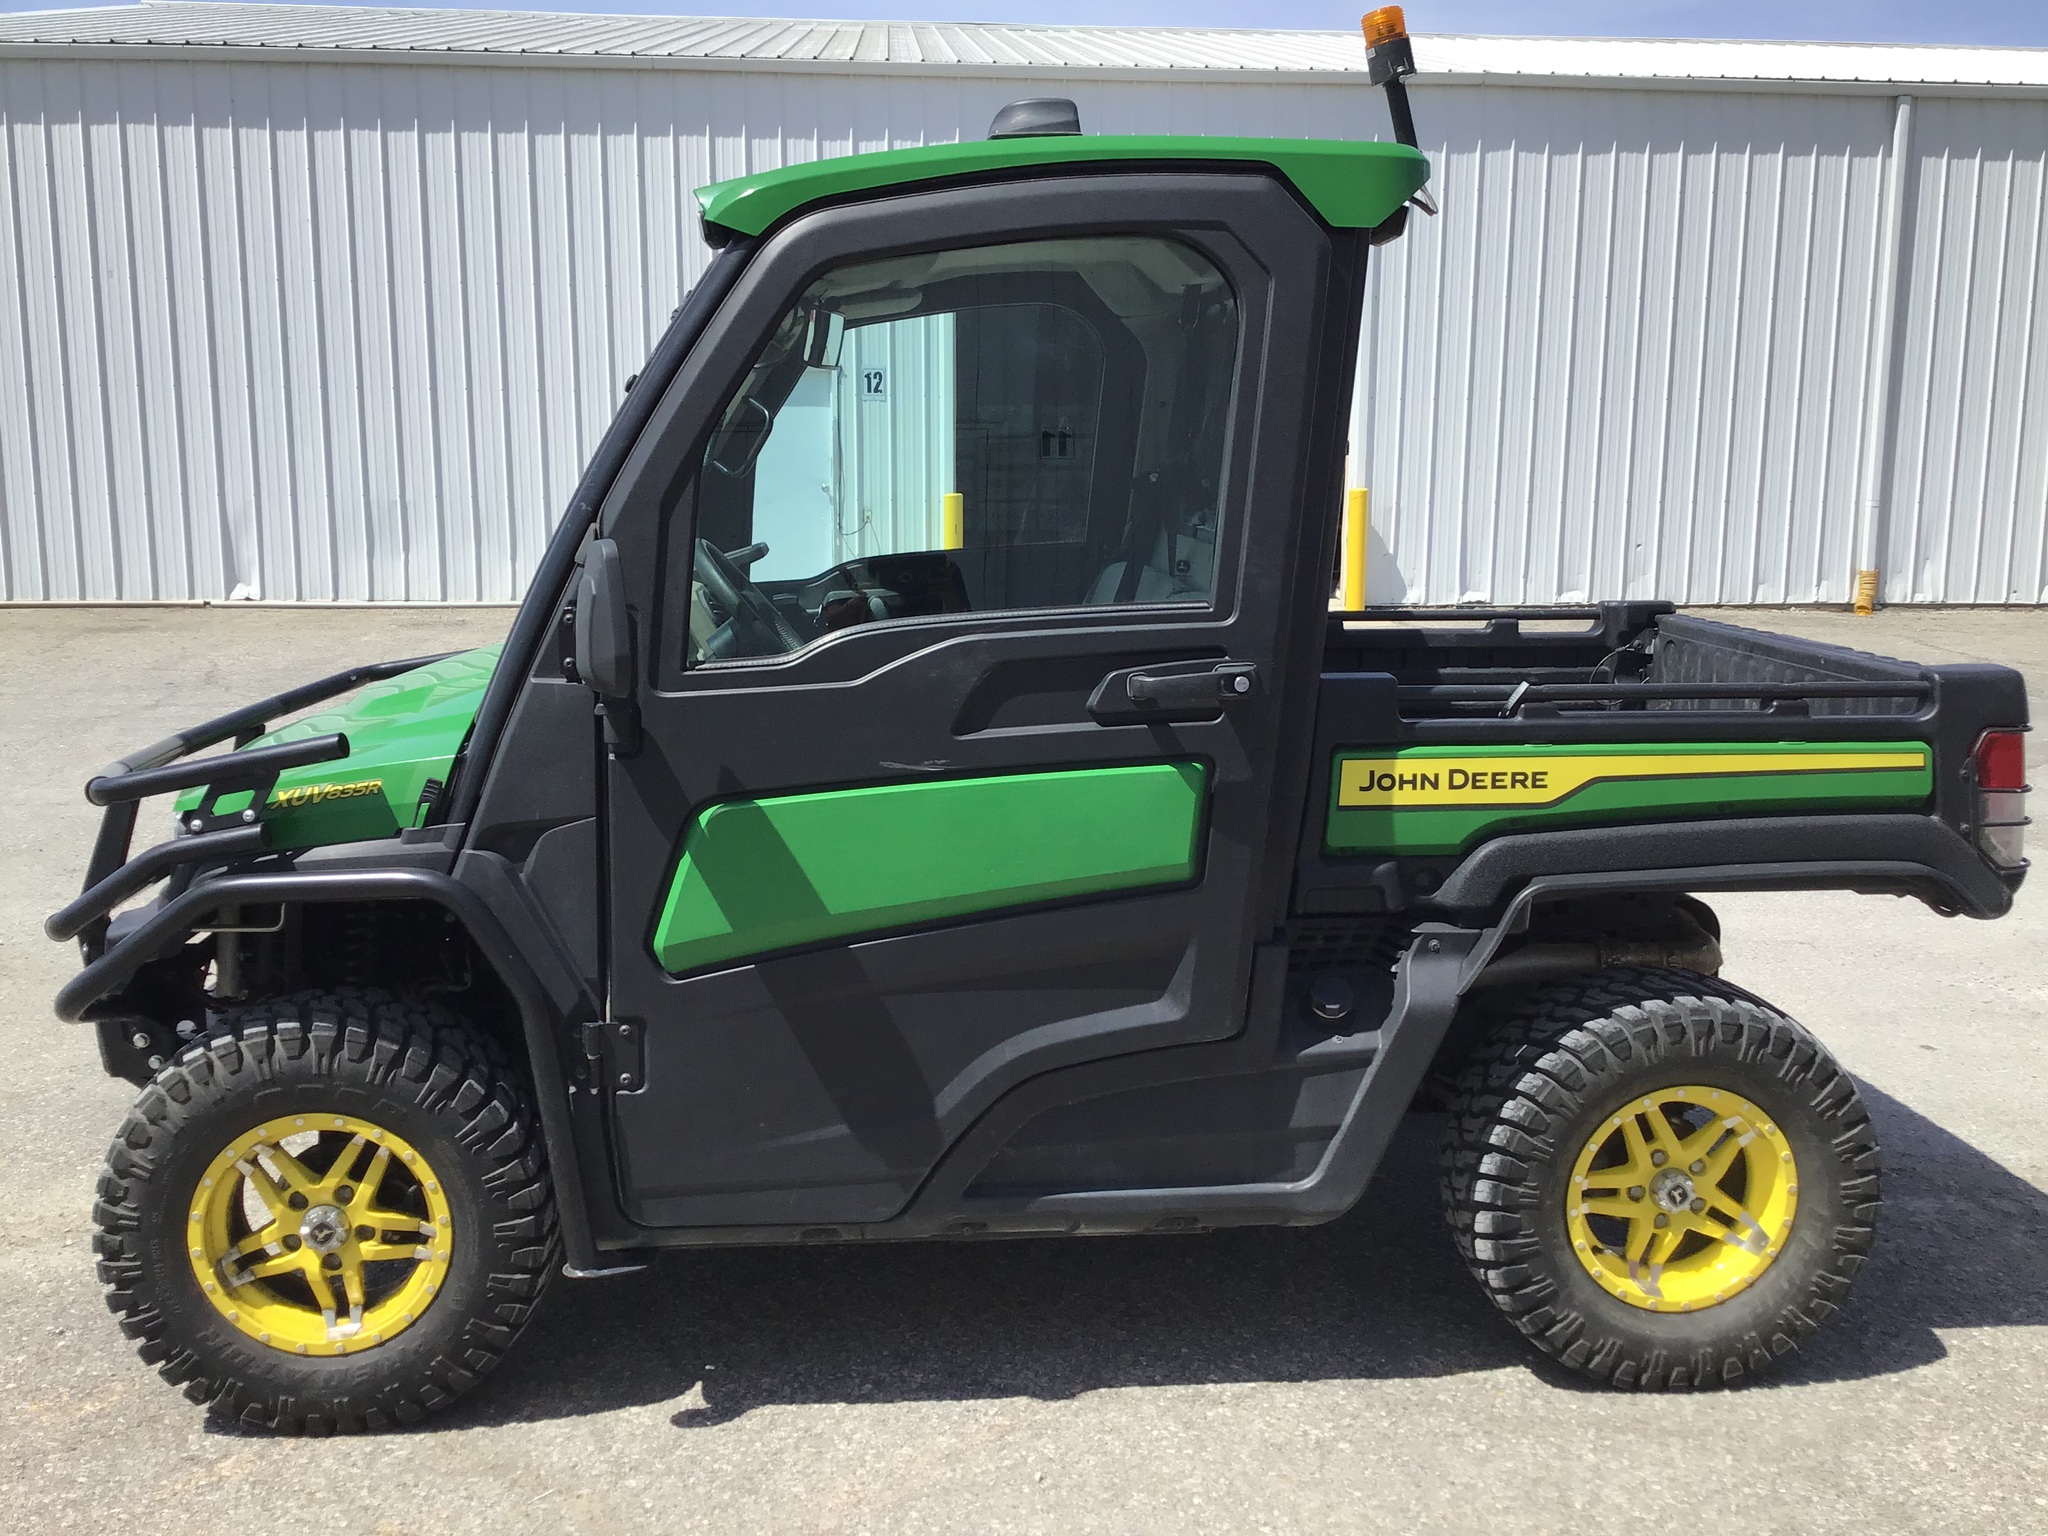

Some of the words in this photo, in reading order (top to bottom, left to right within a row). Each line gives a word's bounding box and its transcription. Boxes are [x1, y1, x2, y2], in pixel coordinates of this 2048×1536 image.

[864, 371, 883, 394] 12
[1359, 769, 1439, 792] JOHN
[1448, 768, 1549, 791] DEERE
[269, 779, 383, 810] XUV835R
